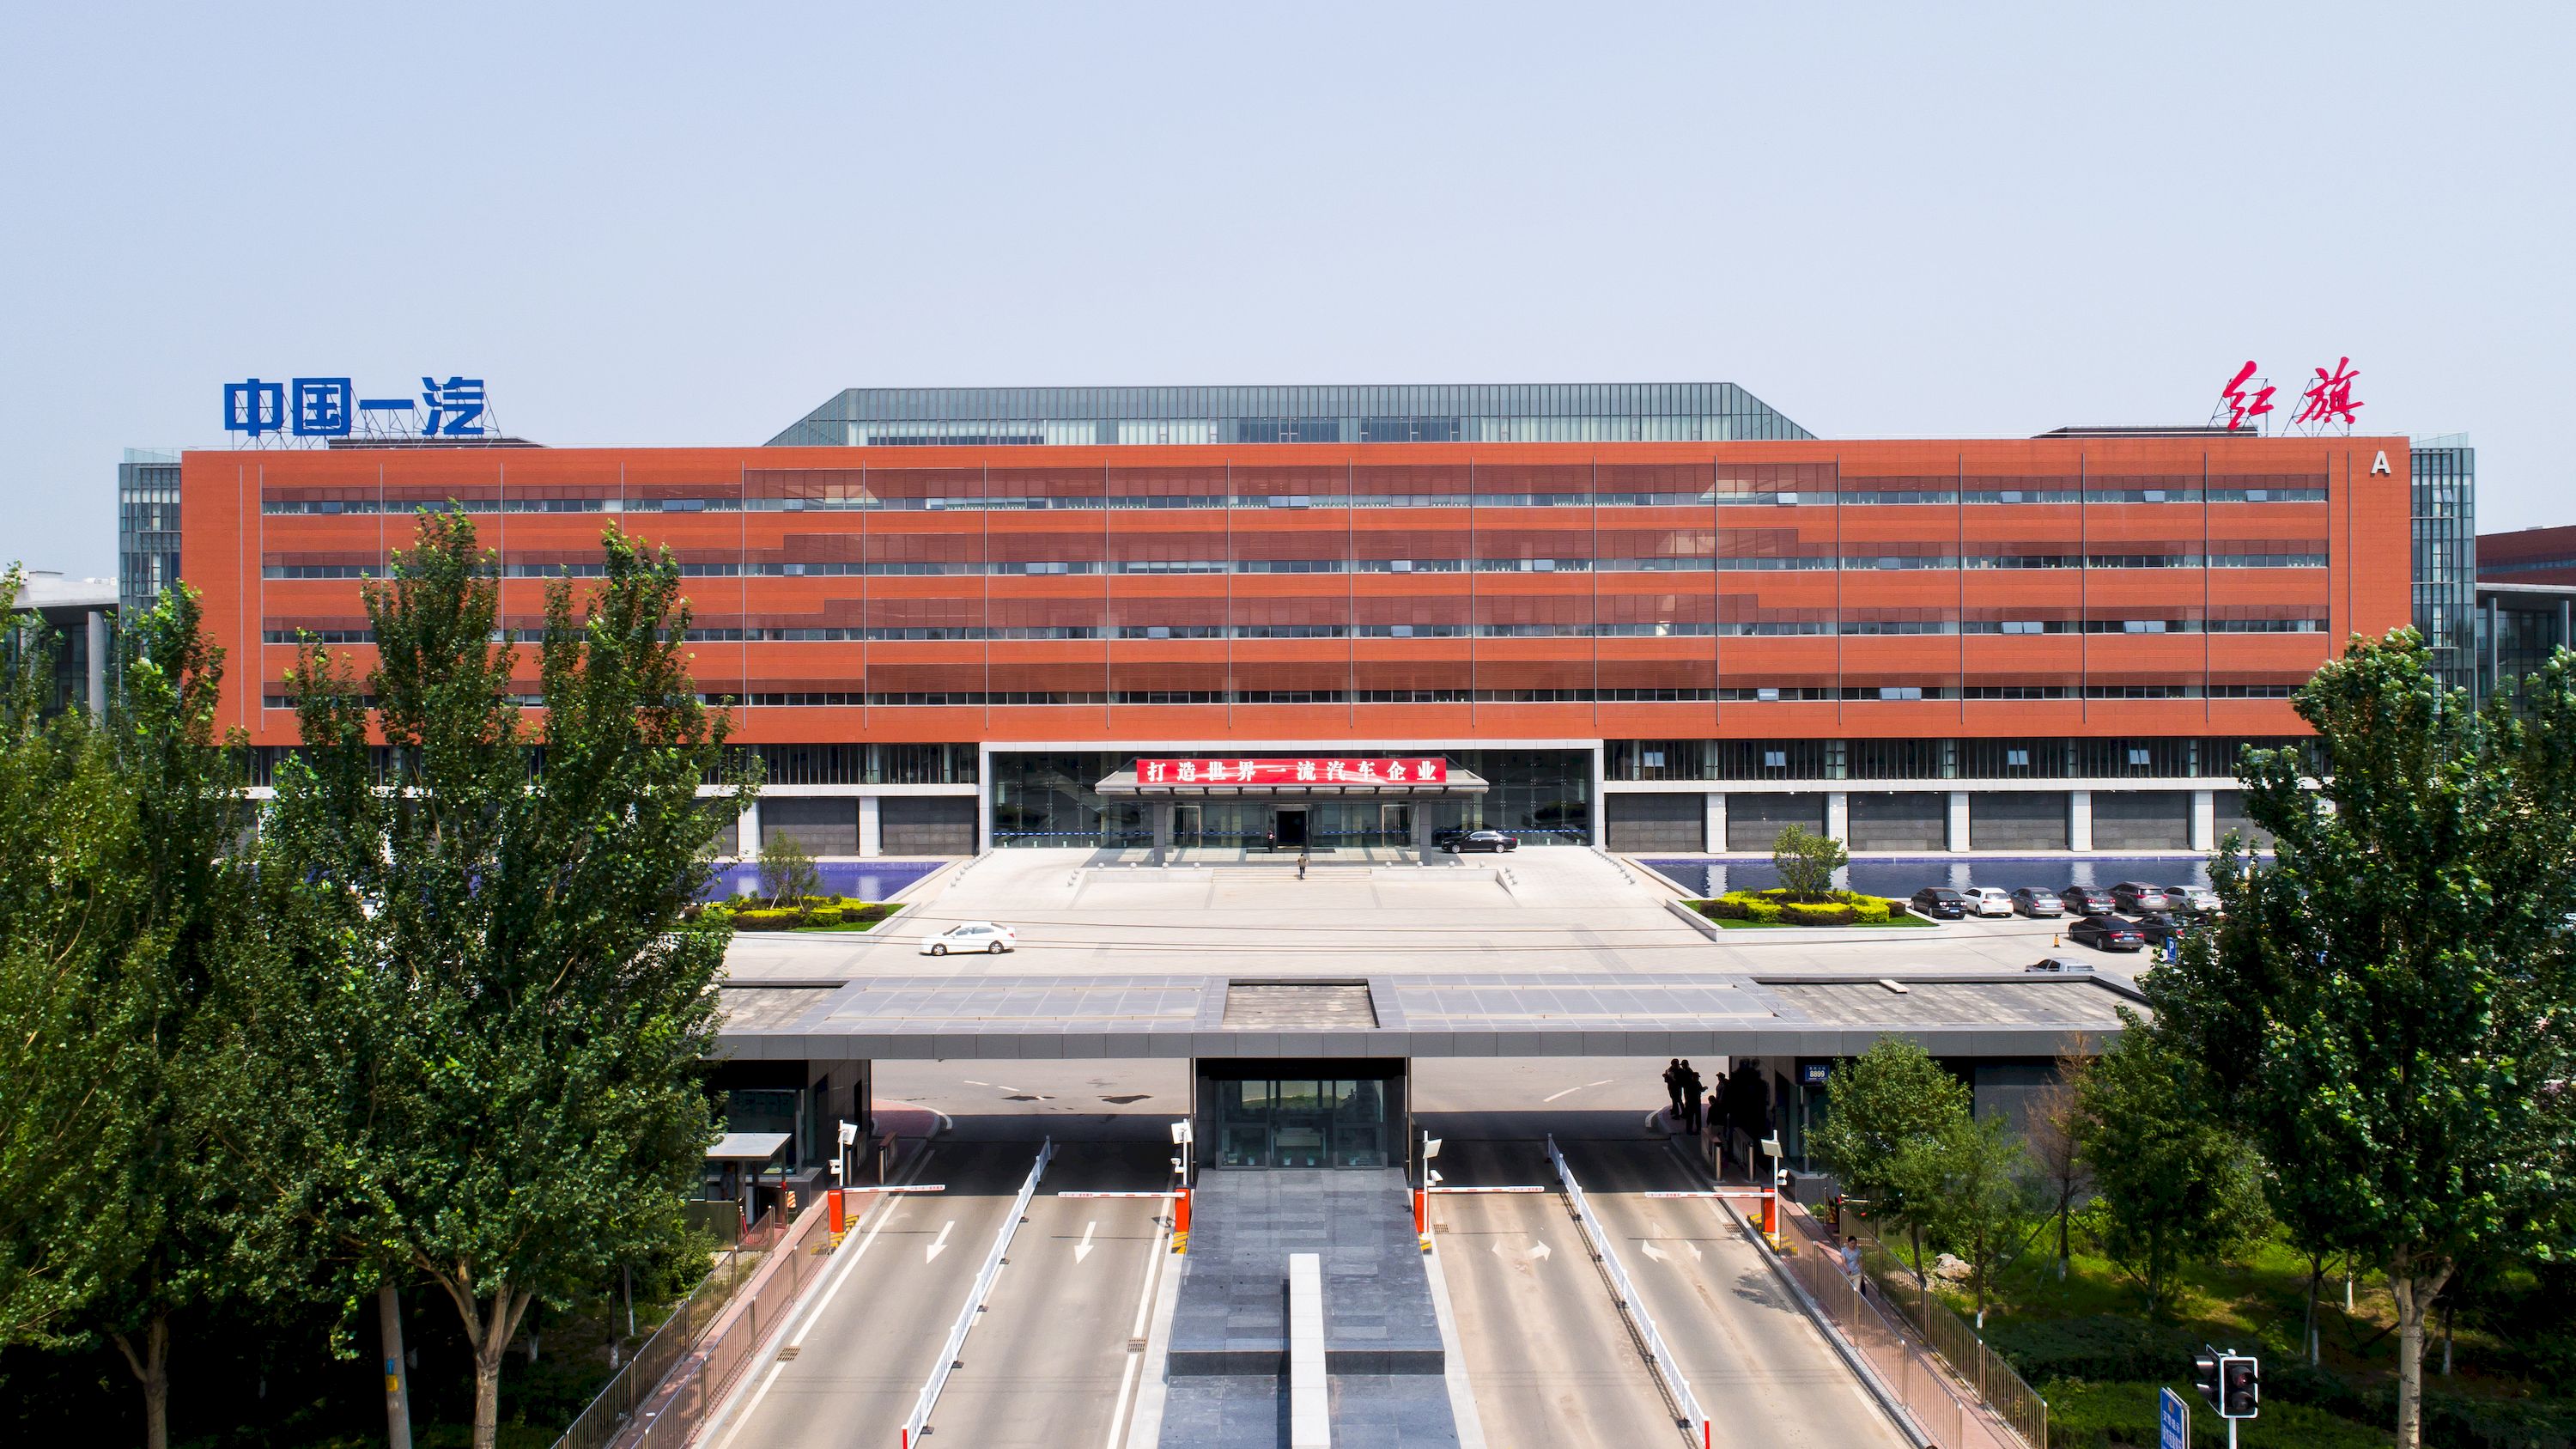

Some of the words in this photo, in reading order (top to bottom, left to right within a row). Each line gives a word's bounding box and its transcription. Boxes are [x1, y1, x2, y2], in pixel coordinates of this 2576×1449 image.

[2222, 356, 2365, 429] 红旗
[224, 376, 484, 436] 中国一汽
[2371, 450, 2391, 475] A
[1147, 760, 1437, 782] 打造世界一流汽车企业
[2168, 941, 2174, 953] P
